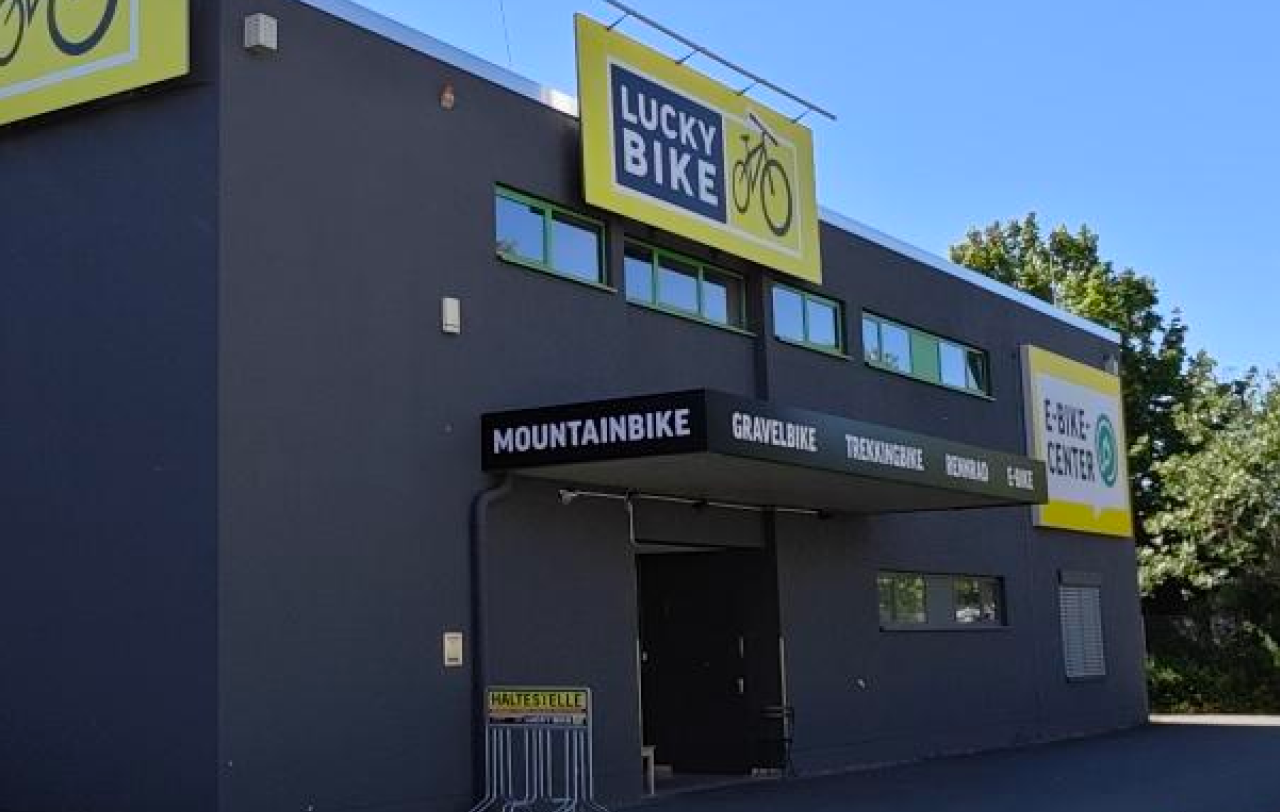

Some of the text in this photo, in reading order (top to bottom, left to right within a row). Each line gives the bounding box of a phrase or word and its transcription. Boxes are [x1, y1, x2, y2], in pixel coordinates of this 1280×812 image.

[621, 84, 717, 156] LUCKY
[623, 128, 719, 206] BIKE
[493, 408, 691, 454] MOUNTAINBIKE
[732, 411, 818, 452] GRAVELBIKE
[845, 434, 925, 471] TREKKINGBIKE
[1044, 398, 1091, 441] E-BIKE-
[1048, 441, 1095, 482] CENTER
[491, 693, 583, 708] HALTESTELLE
